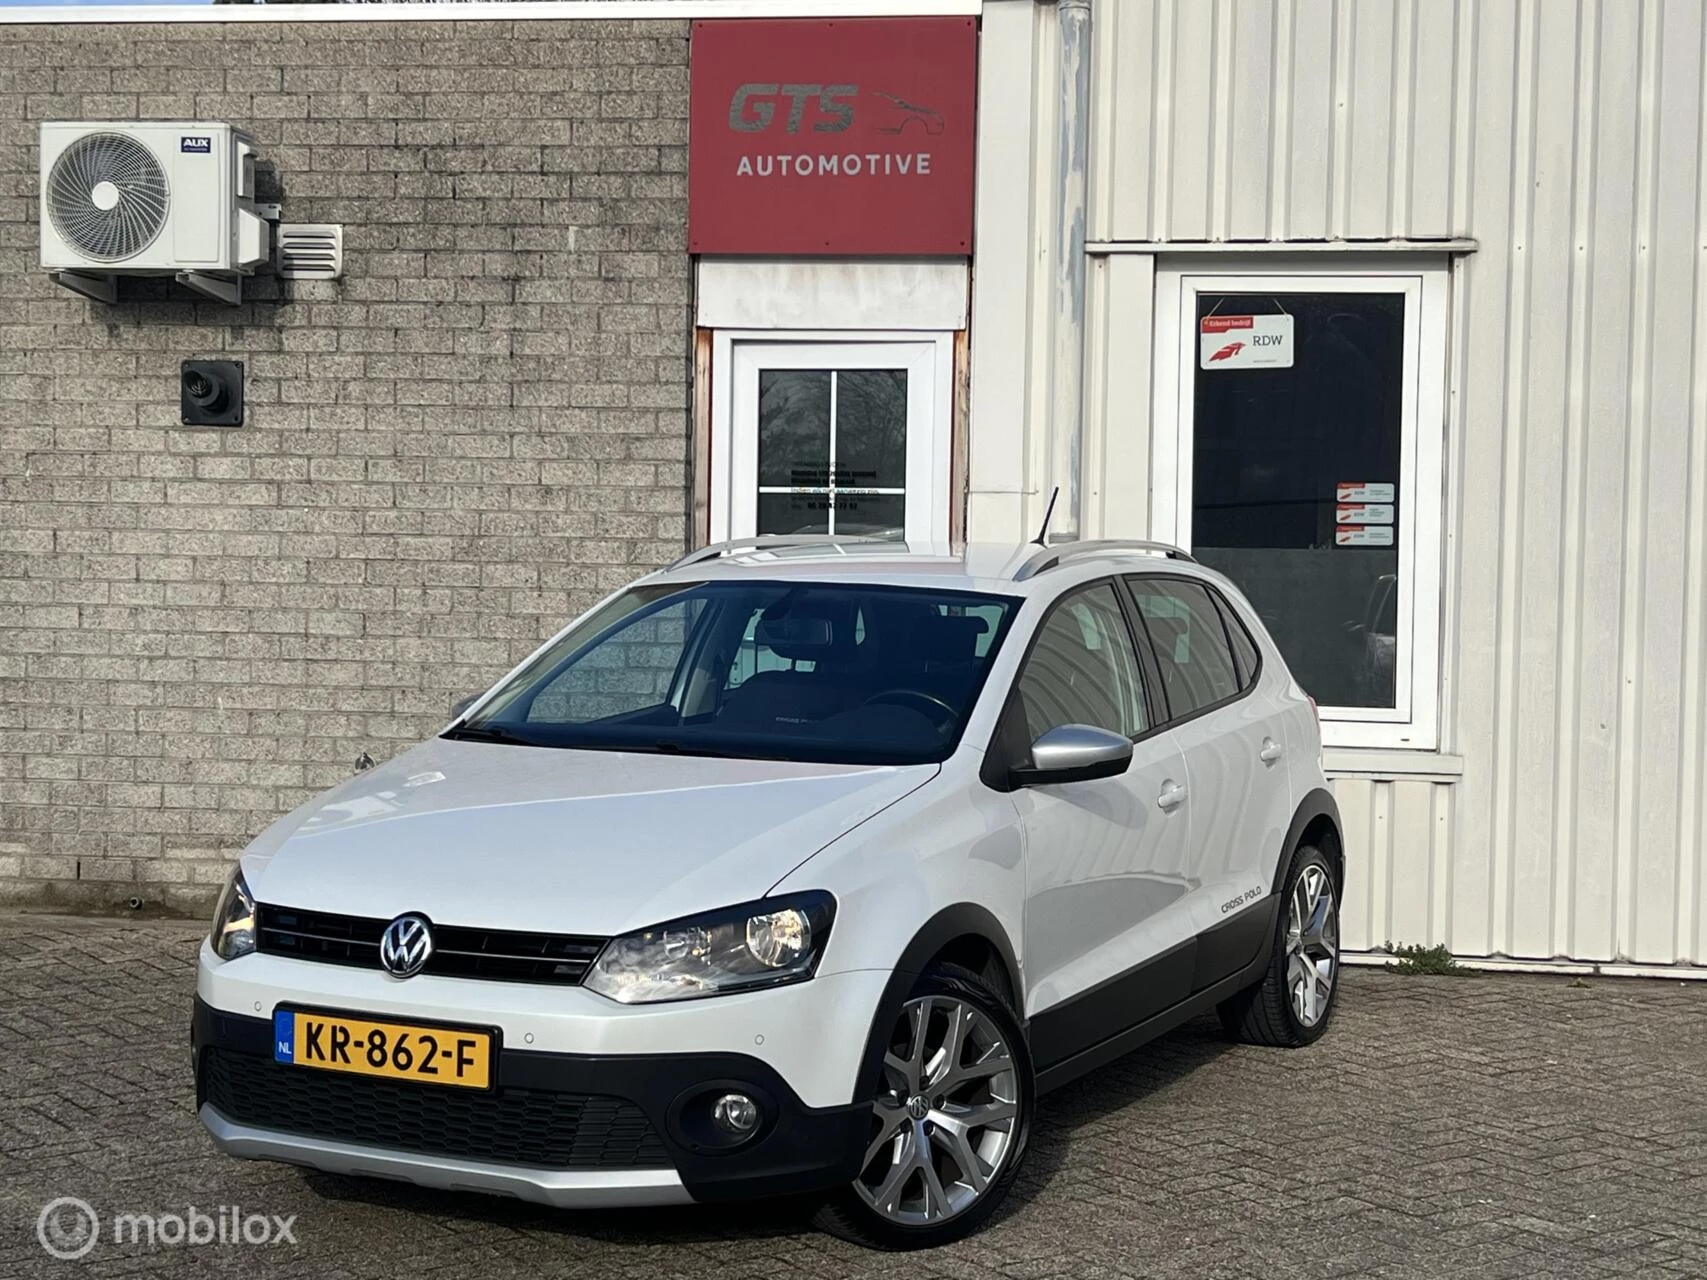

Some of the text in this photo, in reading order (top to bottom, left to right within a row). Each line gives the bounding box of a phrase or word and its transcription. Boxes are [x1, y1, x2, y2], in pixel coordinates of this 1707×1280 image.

[727, 83, 859, 134] GTS
[183, 138, 209, 147] AUX
[736, 153, 931, 177] AUTOMOTIVE
[1252, 335, 1283, 347] RDW
[1220, 886, 1262, 914] CROSS POLO
[278, 1041, 292, 1054] NL
[305, 1022, 477, 1078] KR-862-F
